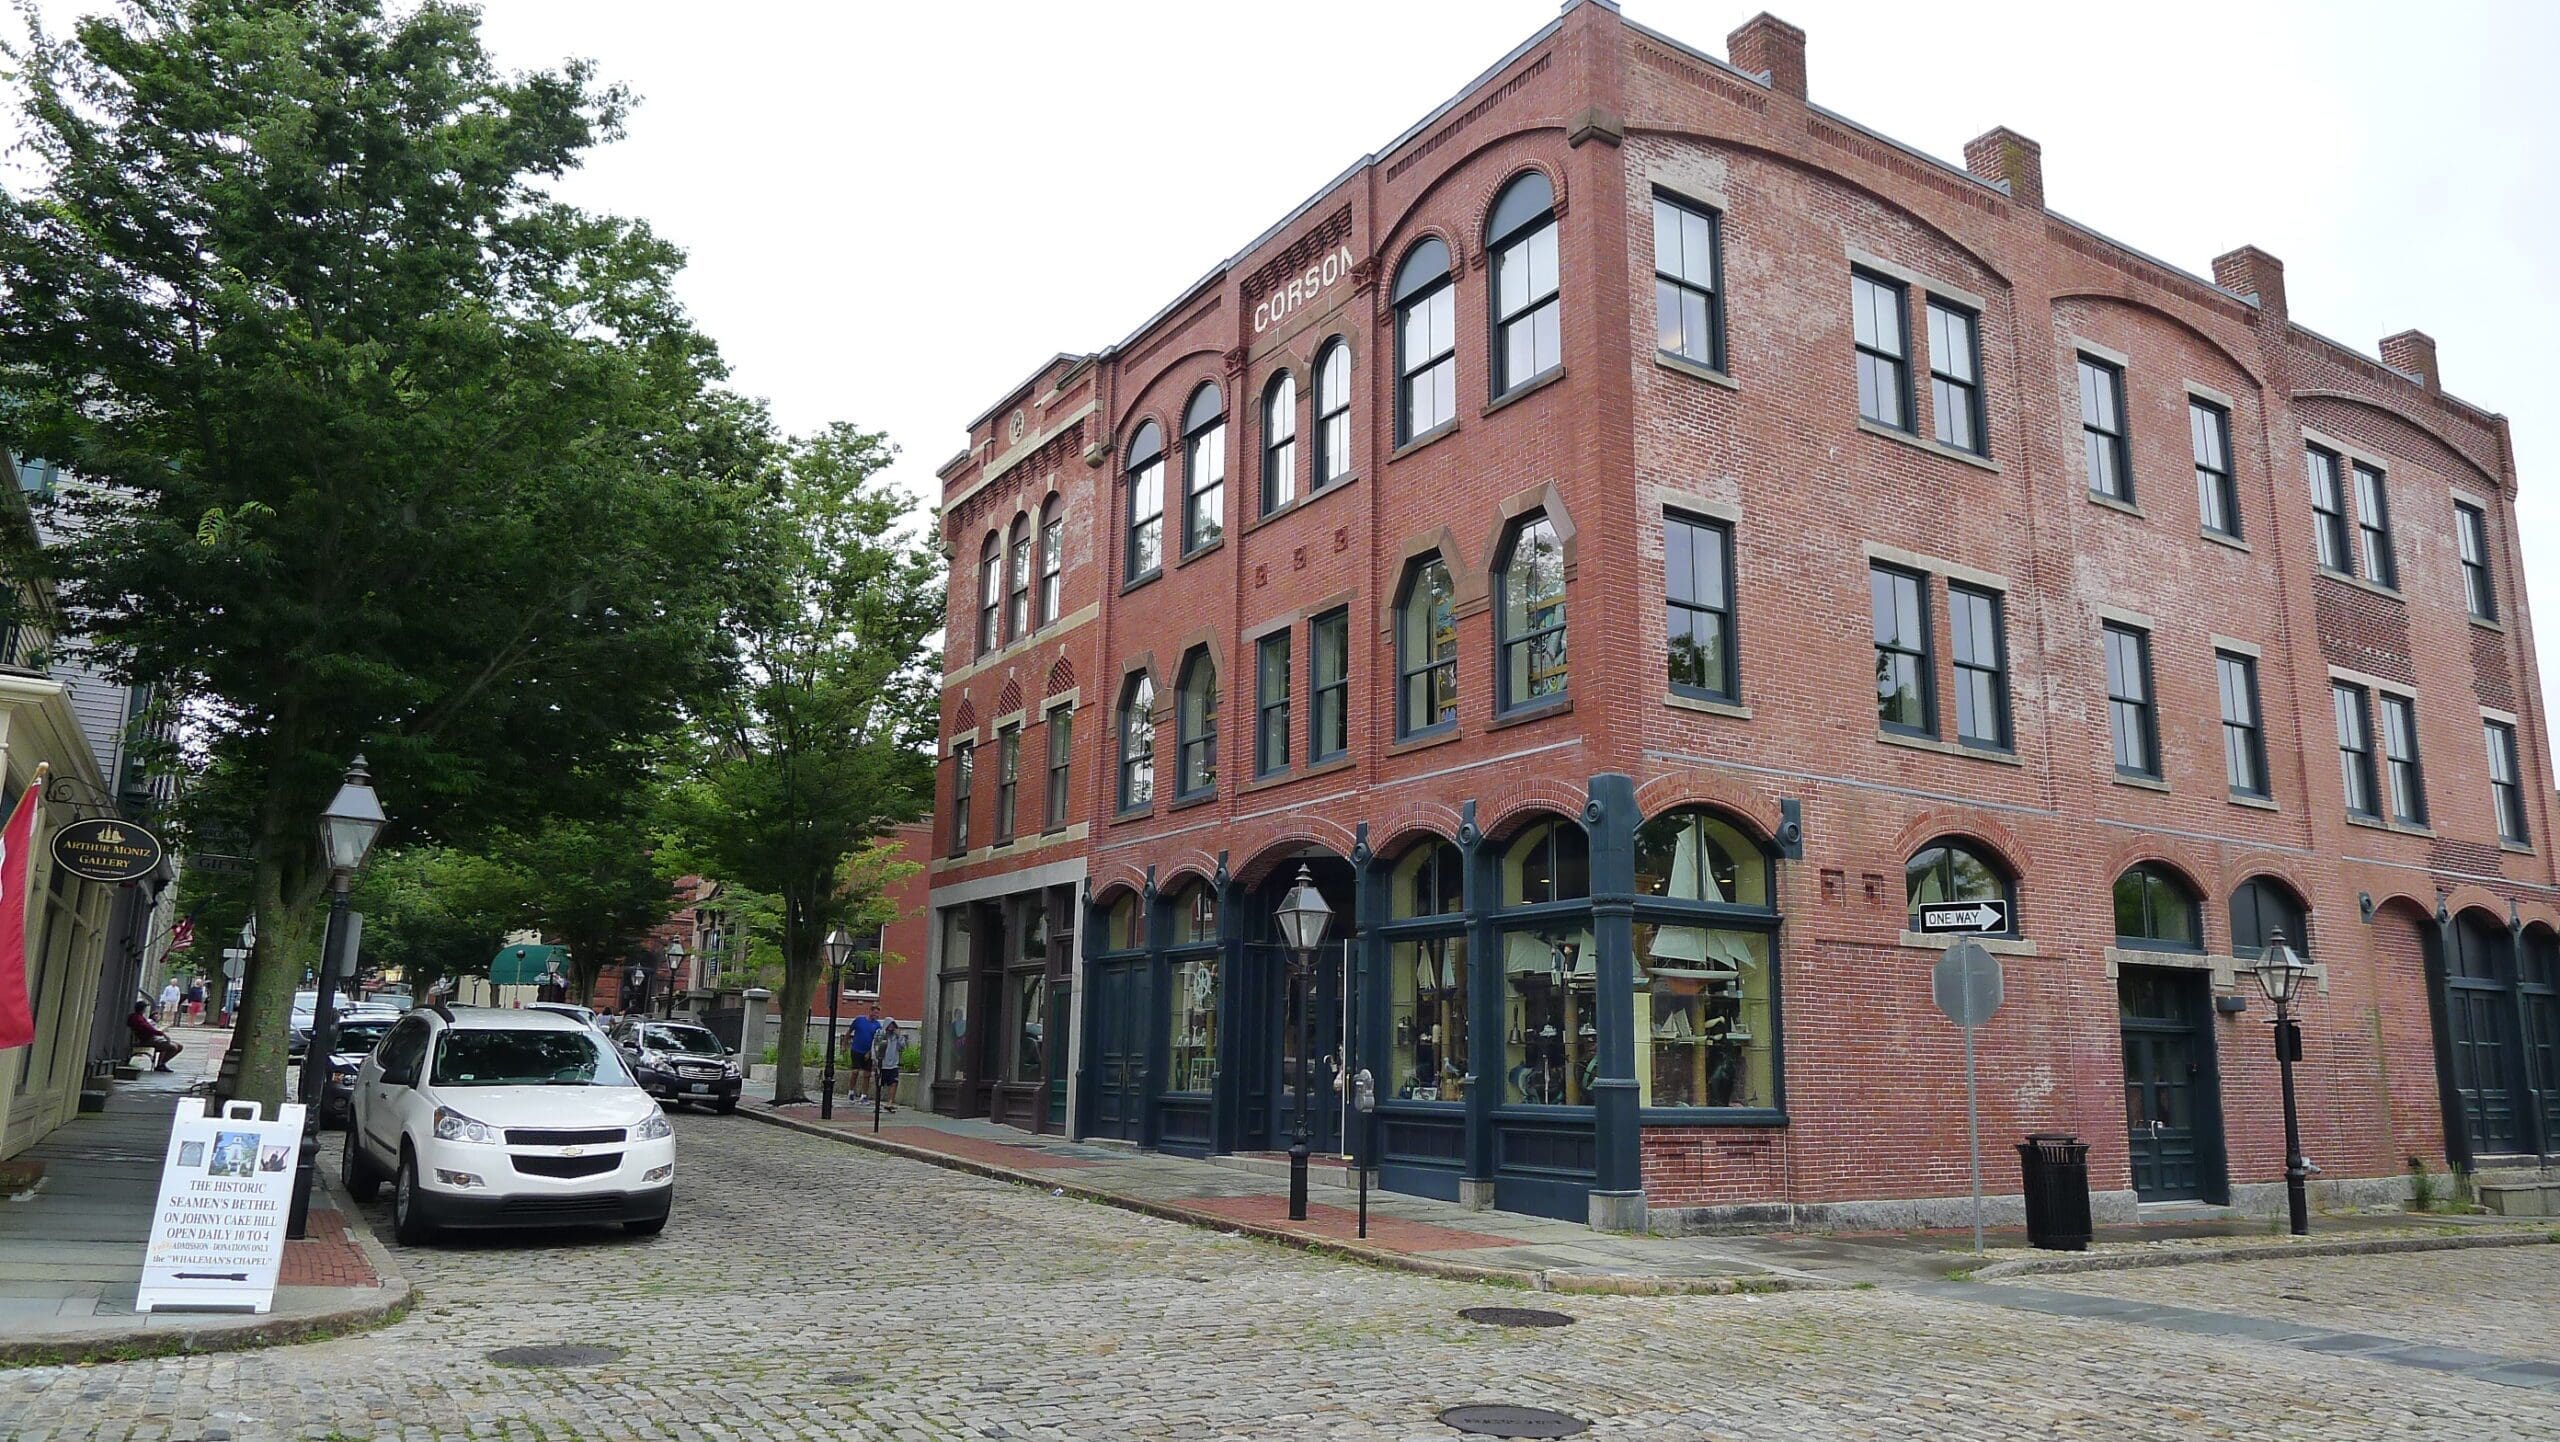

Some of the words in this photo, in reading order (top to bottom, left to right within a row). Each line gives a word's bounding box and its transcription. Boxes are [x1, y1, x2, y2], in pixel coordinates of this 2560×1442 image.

[1254, 246, 1353, 333] CORSON
[64, 841, 110, 852] ARTHUR
[113, 846, 151, 857] MONIZ
[79, 855, 130, 868] GALLERY
[1928, 912, 1951, 925] ONE
[1956, 911, 1979, 924] WAY
[190, 1180, 213, 1191] THE
[214, 1181, 267, 1193] HISTORIC
[169, 1196, 229, 1209] SEAMEN'S
[231, 1199, 278, 1211] BETHEL
[164, 1212, 179, 1223] ON
[180, 1213, 222, 1225] JOHNNY
[224, 1215, 251, 1226] CAKE
[253, 1216, 278, 1227] HILL
[167, 1228, 197, 1239] OPEN
[198, 1229, 231, 1240] DAILY
[234, 1230, 244, 1240] 10
[247, 1230, 262, 1241] TO
[263, 1231, 270, 1241] 4
[172, 1242, 209, 1251] ADMISSION
[213, 1243, 251, 1252] DONATIONS
[251, 1244, 269, 1252] ONLY
[153, 1254, 165, 1262] the
